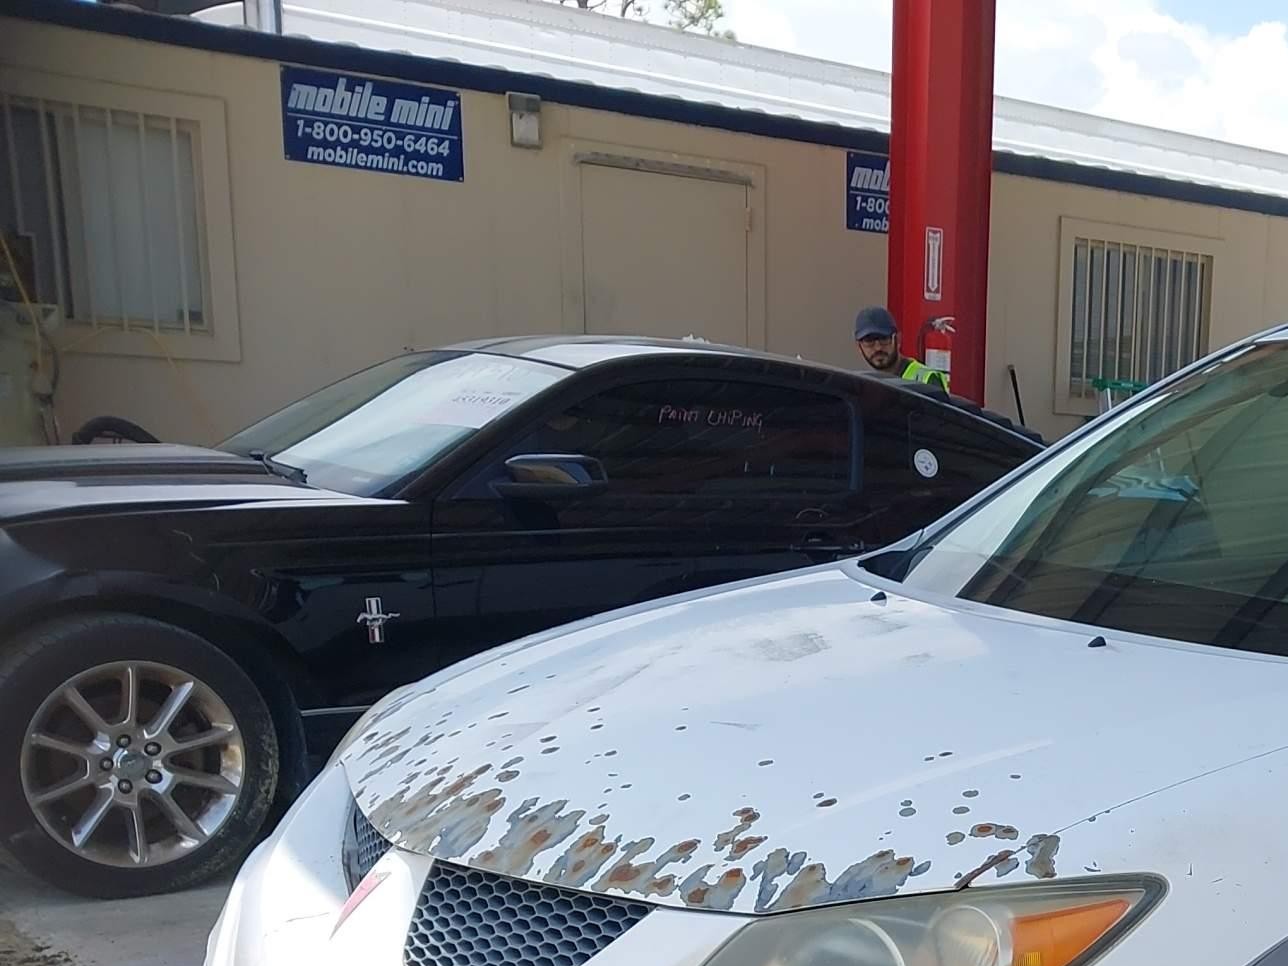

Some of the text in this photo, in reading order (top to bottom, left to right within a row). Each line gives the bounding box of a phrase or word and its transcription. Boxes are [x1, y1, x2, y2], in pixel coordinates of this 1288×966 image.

[287, 77, 455, 130] mobile mini
[297, 119, 450, 157] 1-800-950-6464
[307, 145, 444, 177] mobilemini.com
